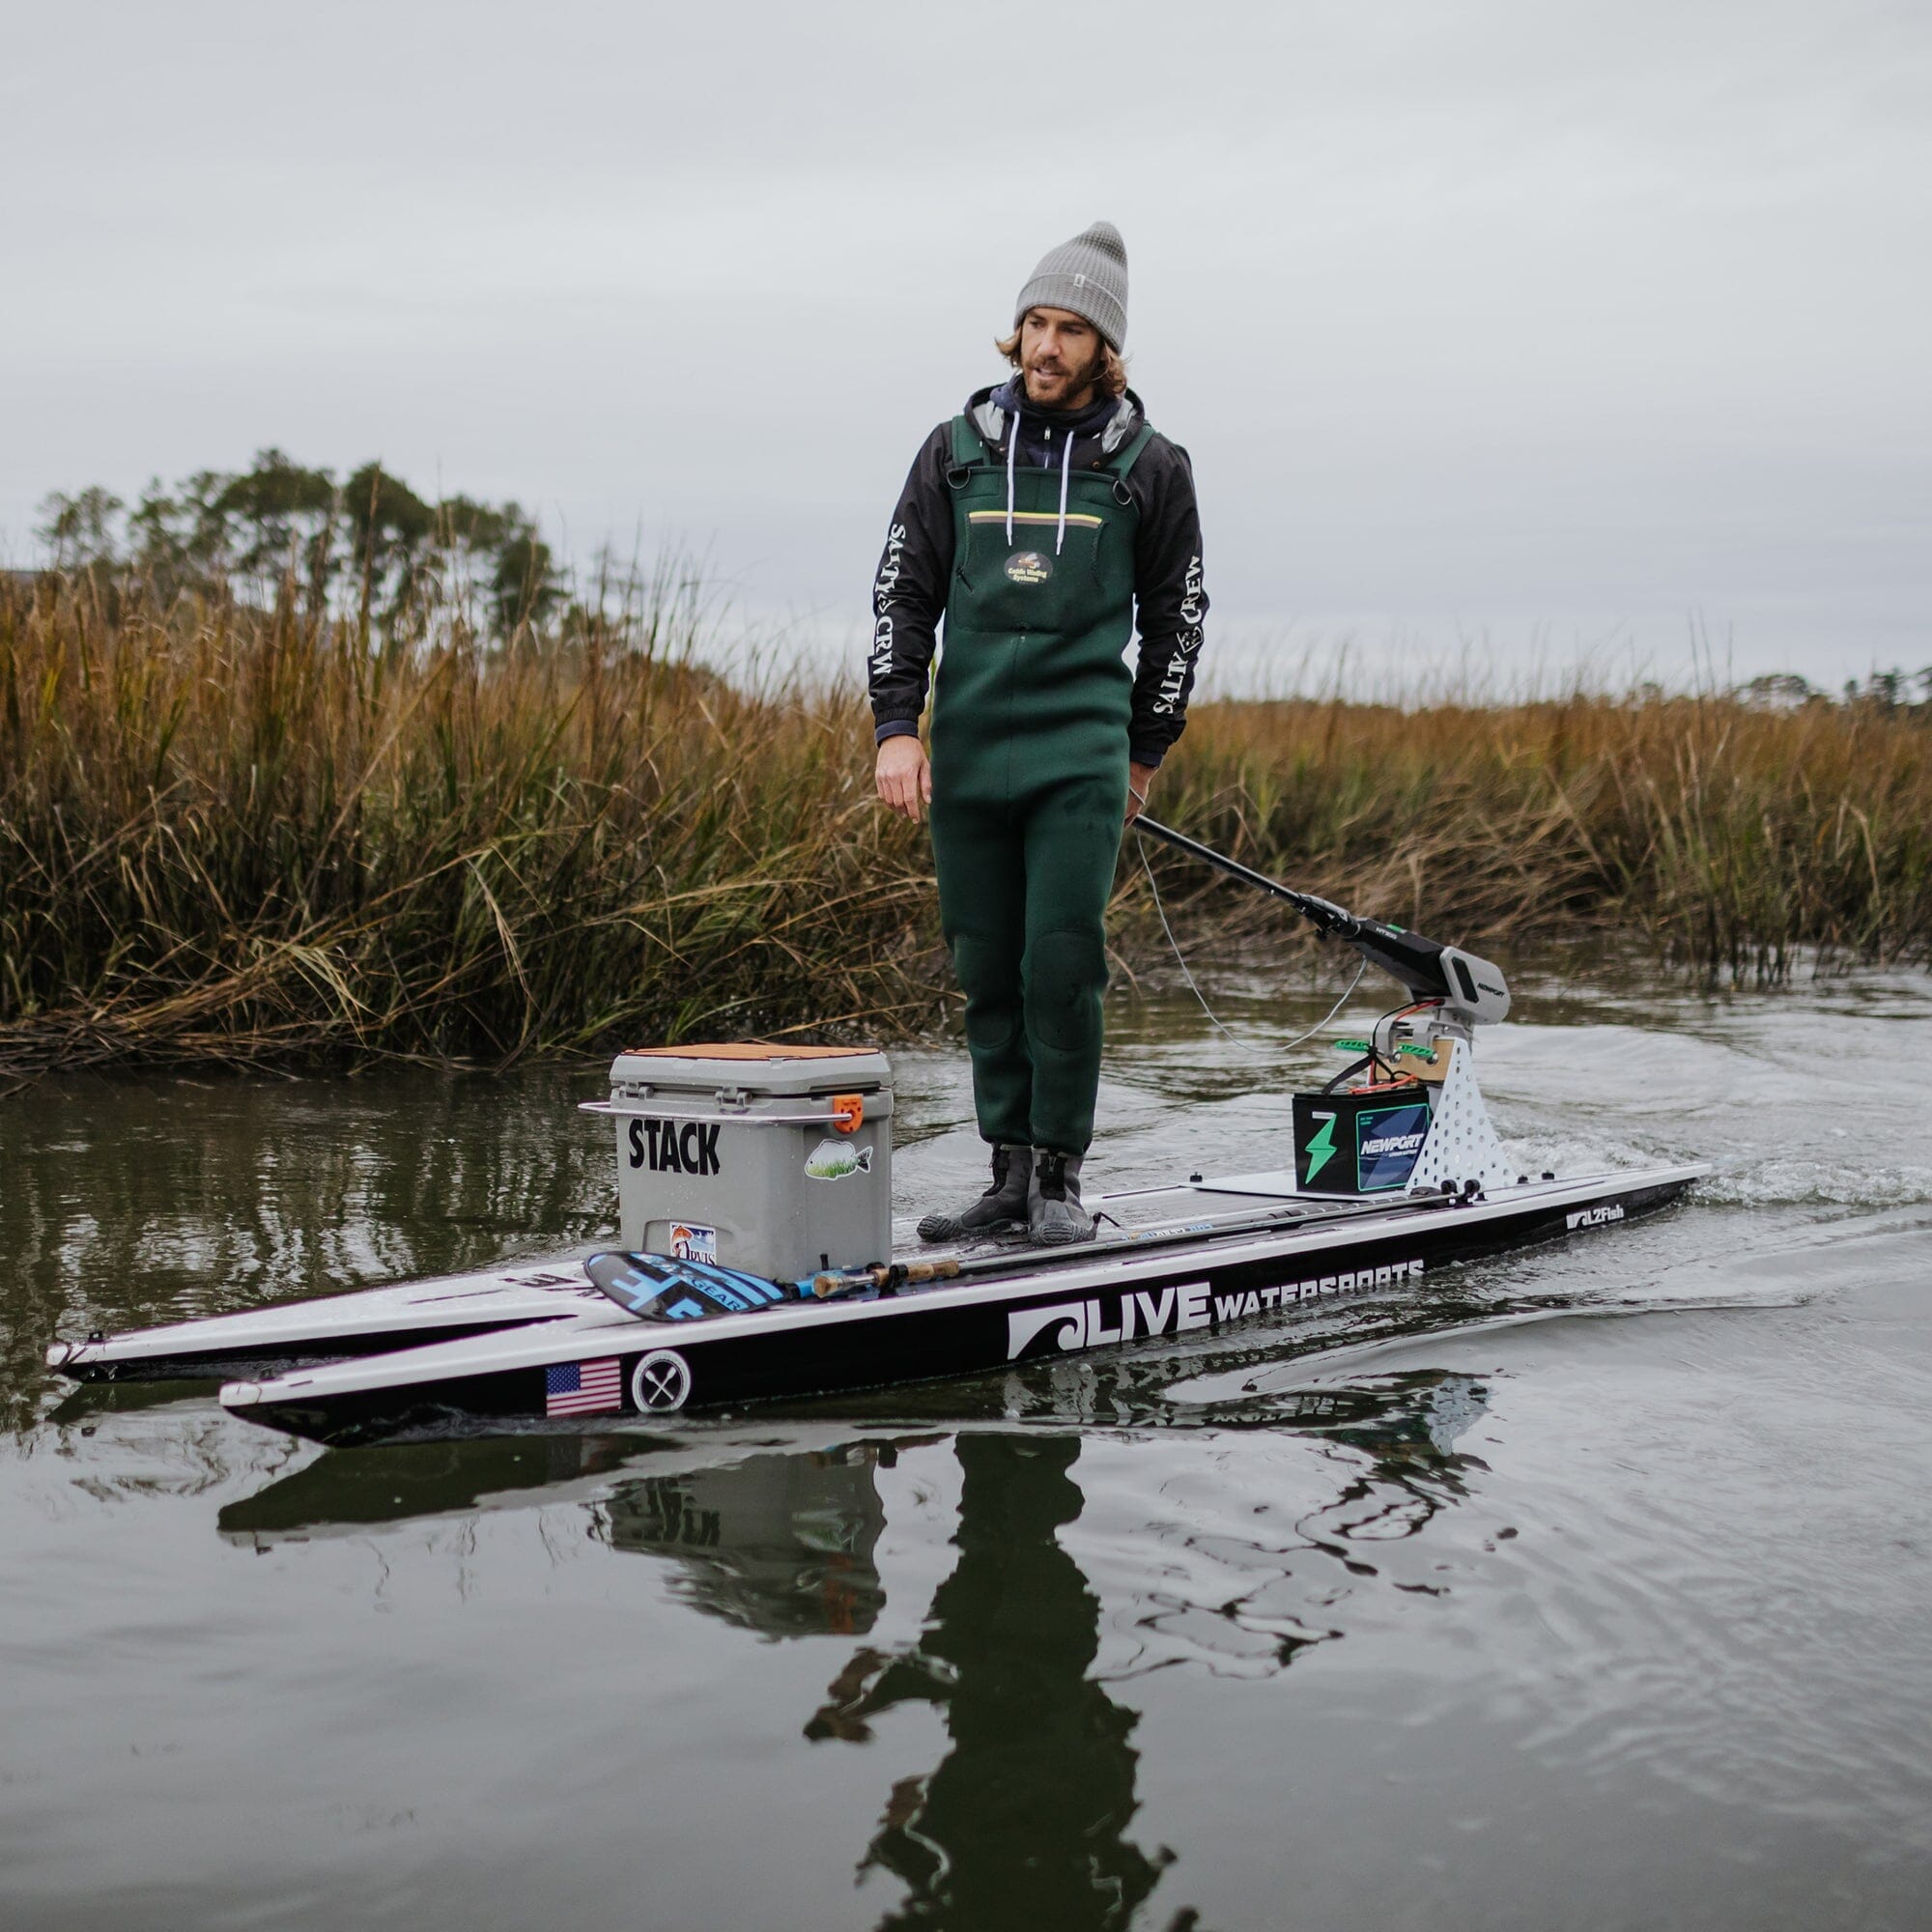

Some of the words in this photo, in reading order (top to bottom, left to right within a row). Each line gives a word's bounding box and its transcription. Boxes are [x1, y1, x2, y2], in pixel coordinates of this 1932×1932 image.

[874, 524, 906, 593] SALTY
[871, 615, 894, 675] CRW
[1152, 651, 1188, 714] SALTY
[1180, 555, 1203, 625] CREW
[628, 1118, 721, 1176] STACK
[1360, 1133, 1425, 1155] NEWPORT
[690, 1277, 742, 1312] GEAR
[1085, 1281, 1211, 1348] LIVE
[1214, 1259, 1425, 1321] WATERSPORTS
